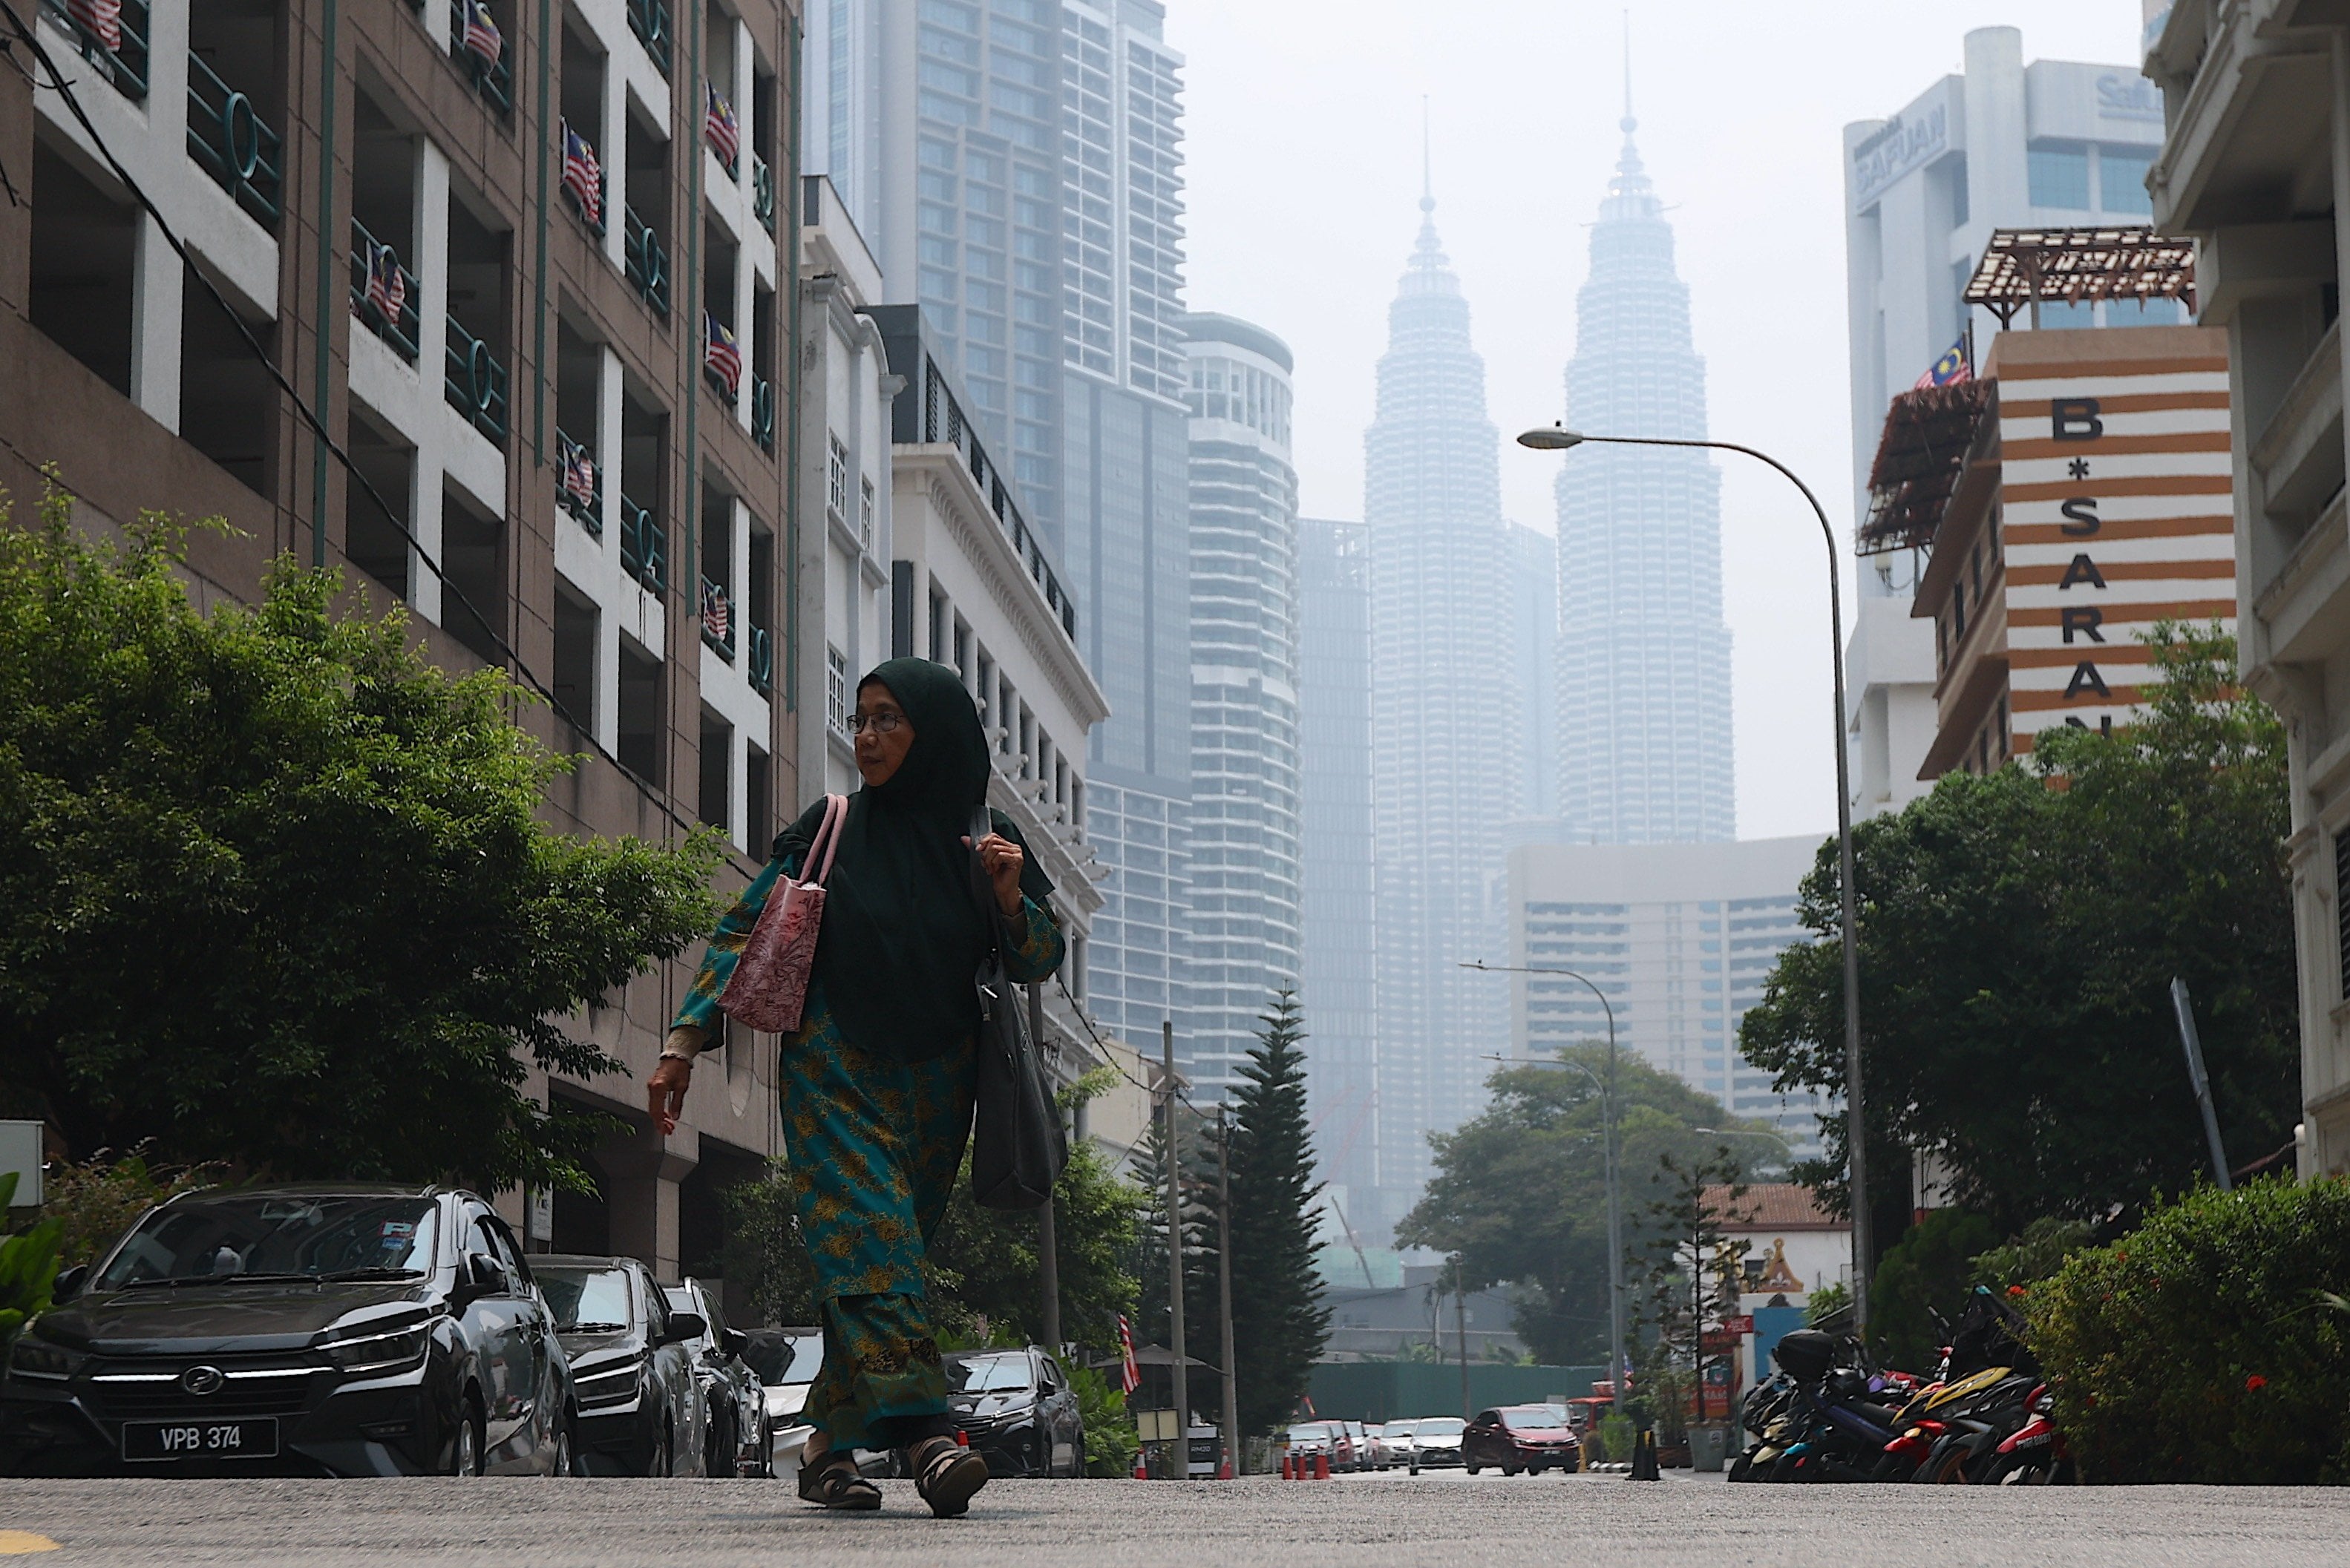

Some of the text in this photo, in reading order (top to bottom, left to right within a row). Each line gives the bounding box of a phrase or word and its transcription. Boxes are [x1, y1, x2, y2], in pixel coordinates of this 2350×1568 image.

[1856, 104, 1945, 194] SAFUAN
[161, 1425, 241, 1451] VPB 374
